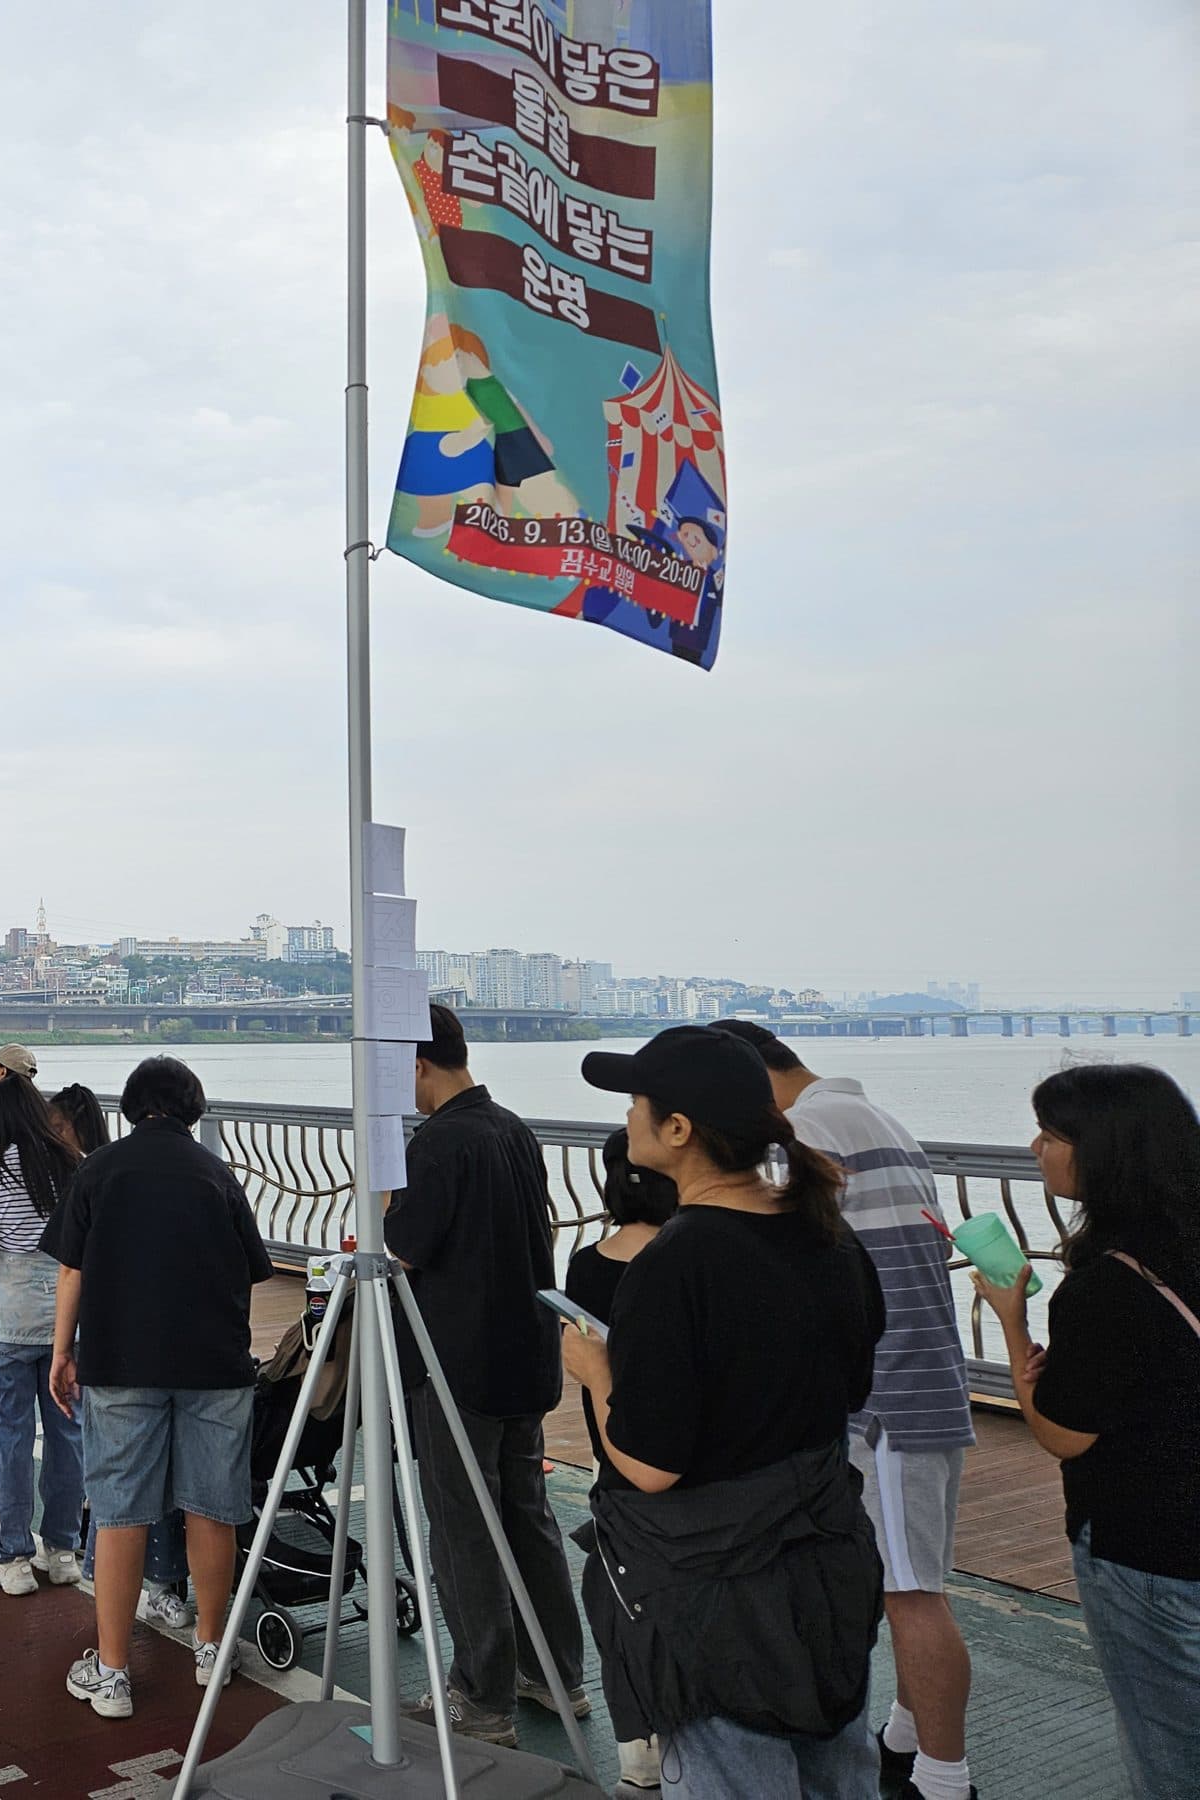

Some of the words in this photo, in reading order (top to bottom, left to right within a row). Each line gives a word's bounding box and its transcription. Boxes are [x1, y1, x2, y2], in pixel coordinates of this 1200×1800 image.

[560, 36, 655, 110] 닿은
[512, 71, 580, 177] 물결,
[448, 133, 559, 243] 손끝에
[565, 198, 650, 276] 닿는
[521, 247, 590, 329] 운명
[464, 505, 515, 542] 2026.
[524, 520, 547, 544] 9.
[615, 538, 701, 592] 14:00~20:00
[560, 549, 612, 582] 잠수교
